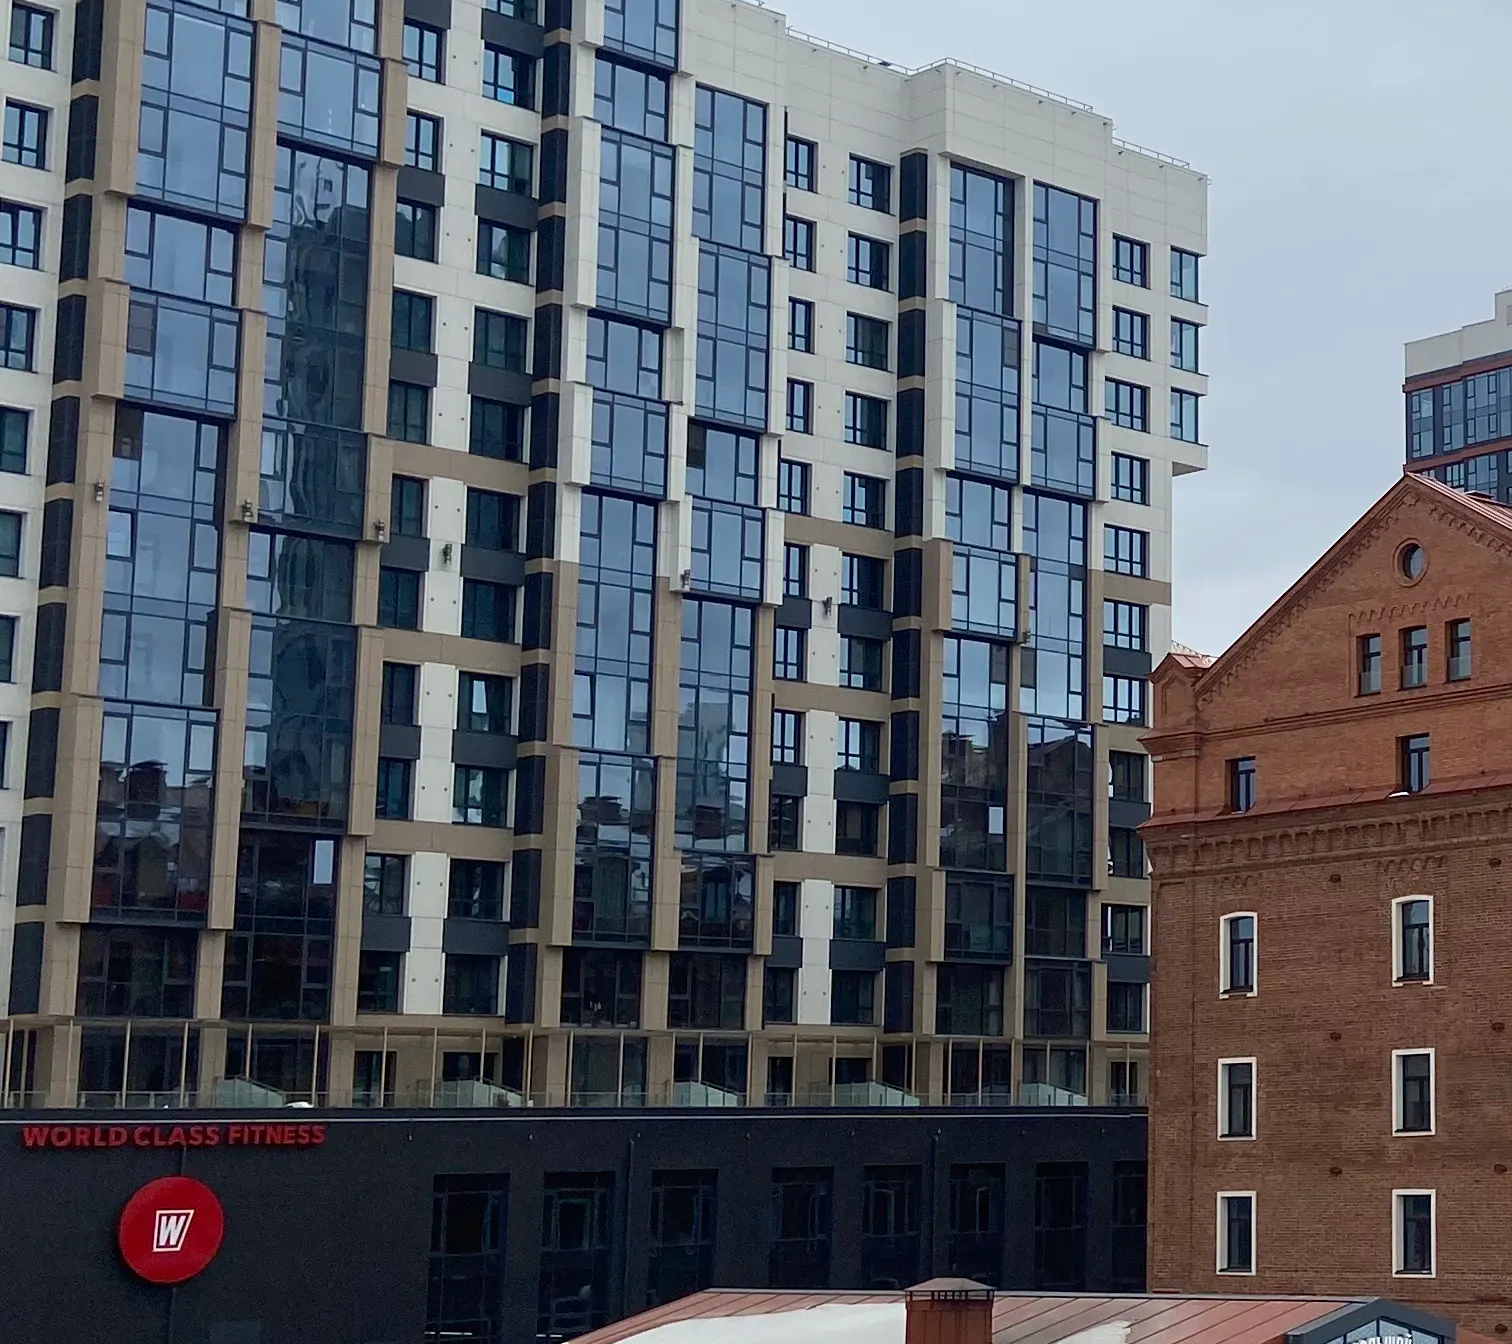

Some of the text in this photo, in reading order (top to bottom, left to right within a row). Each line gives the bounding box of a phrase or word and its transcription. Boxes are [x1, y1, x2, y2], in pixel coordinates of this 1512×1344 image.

[22, 1124, 326, 1148] WORLD CLASS FITNESS
